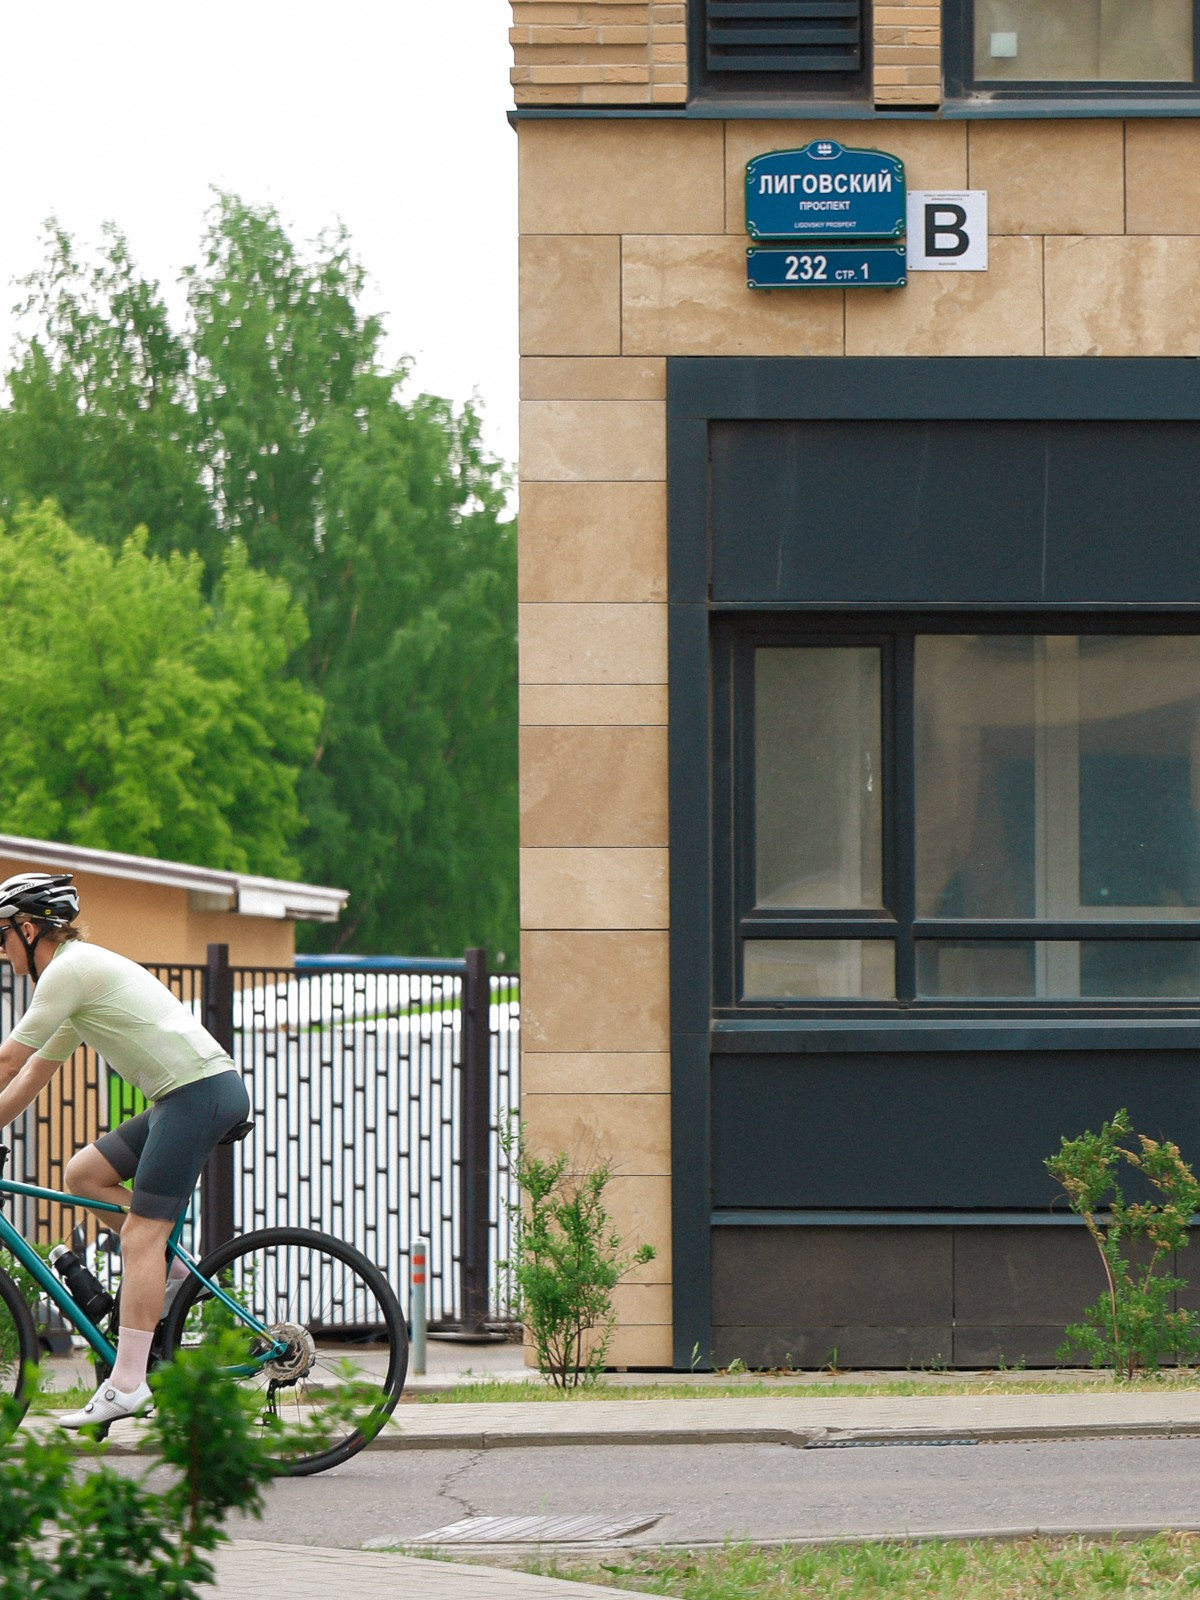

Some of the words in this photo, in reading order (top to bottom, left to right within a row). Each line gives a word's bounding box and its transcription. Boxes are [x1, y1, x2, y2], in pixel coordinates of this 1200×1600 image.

[758, 169, 892, 194] ЛИГОВСКИЙ
[799, 200, 851, 211] ПРОСПЕКТ
[785, 255, 828, 280] 232
[835, 269, 858, 280] СТР.
[860, 262, 869, 280] 1
